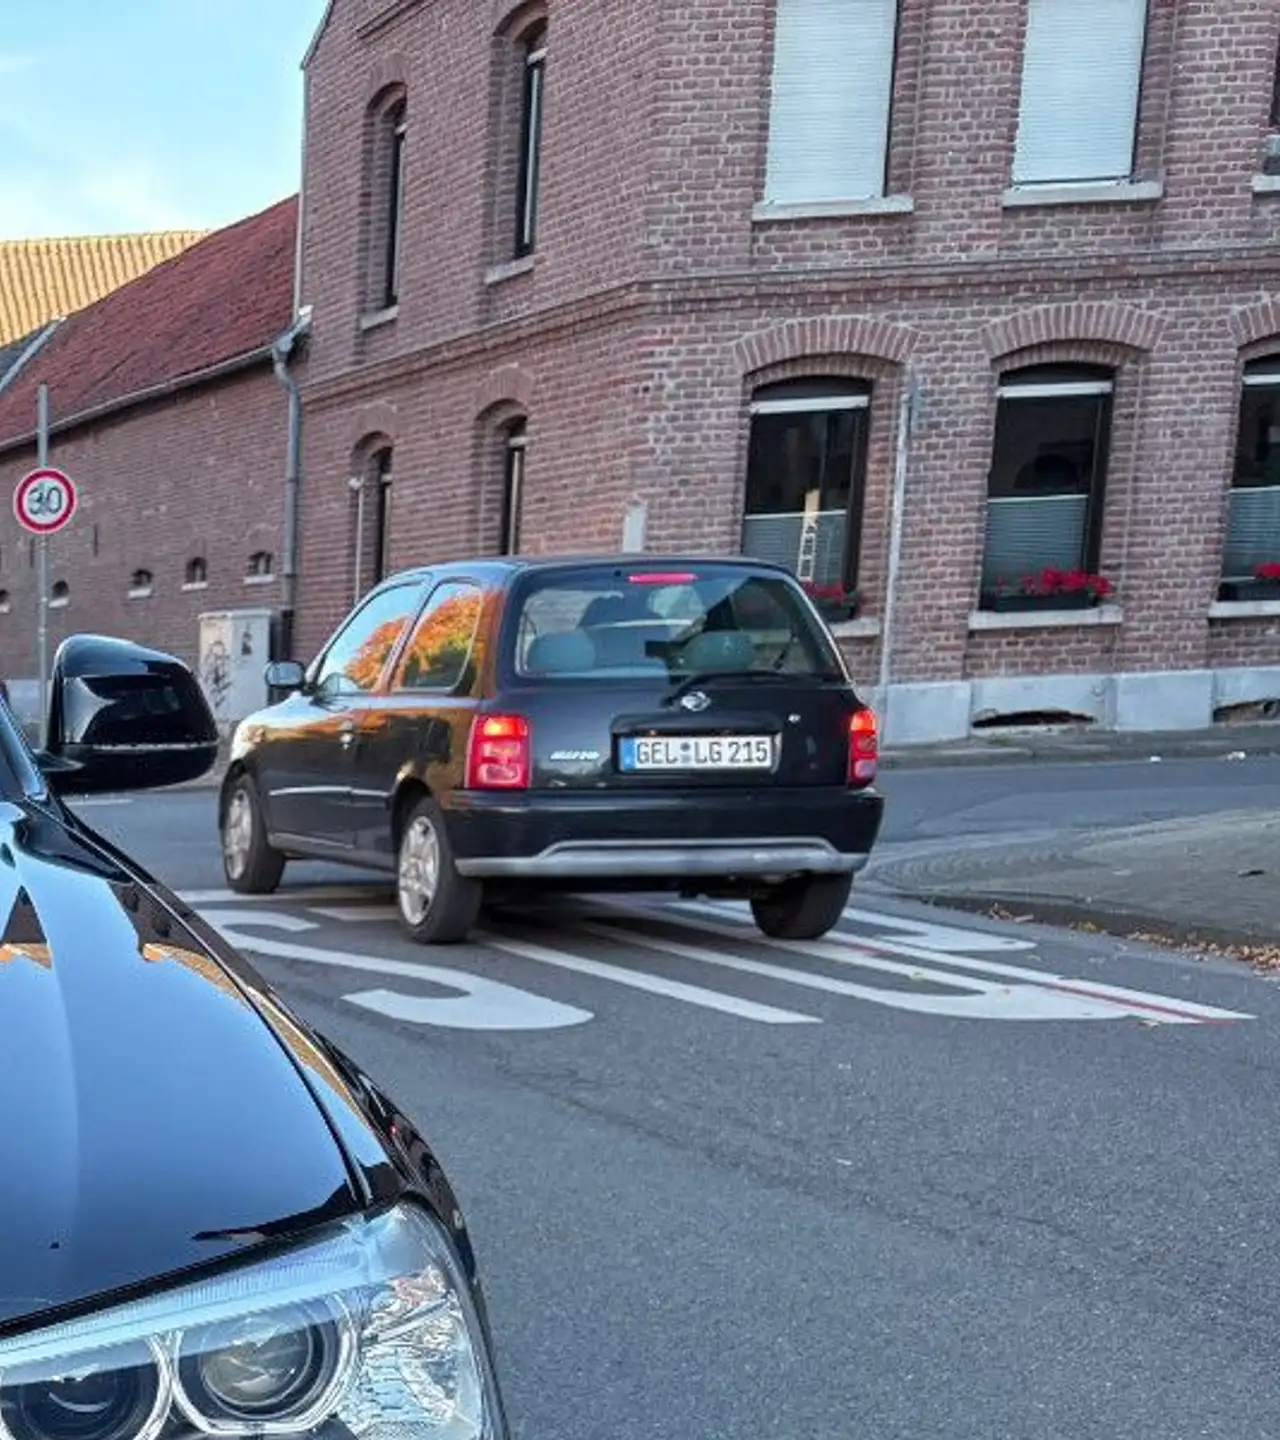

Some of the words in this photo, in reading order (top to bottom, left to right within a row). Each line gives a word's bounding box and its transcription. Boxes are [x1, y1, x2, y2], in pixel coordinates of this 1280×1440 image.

[27, 487, 62, 515] 30
[636, 741, 680, 764] GEL
[694, 741, 722, 764] LG
[727, 740, 769, 763] 215
